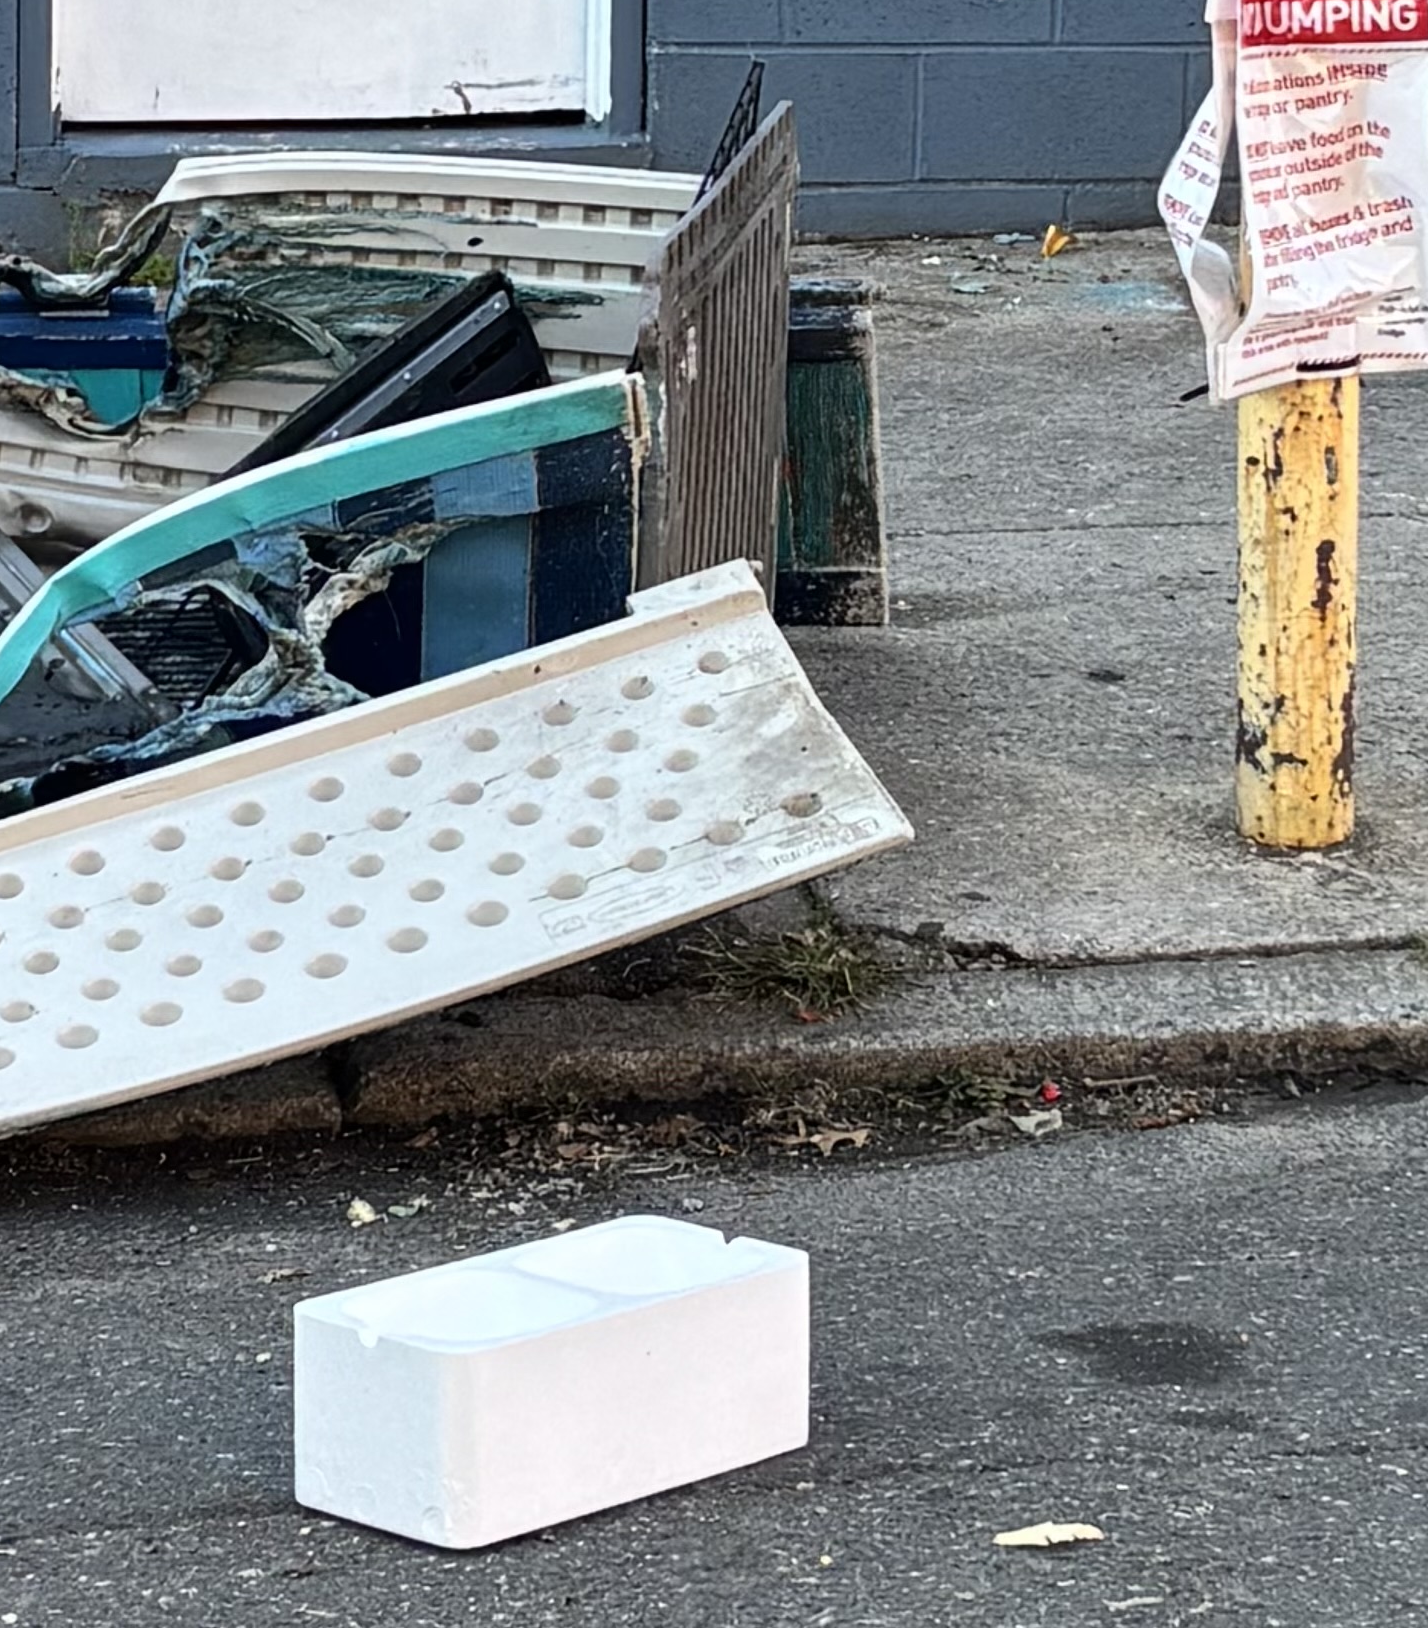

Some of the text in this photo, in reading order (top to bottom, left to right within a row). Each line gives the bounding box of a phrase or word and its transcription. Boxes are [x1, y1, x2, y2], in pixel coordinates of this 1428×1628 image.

[1294, 89, 1354, 114] pantry.
[1310, 126, 1346, 148] food
[1284, 152, 1343, 176] outside
[1358, 141, 1384, 160] the
[1367, 196, 1414, 218] trash
[1381, 214, 1413, 237] and
